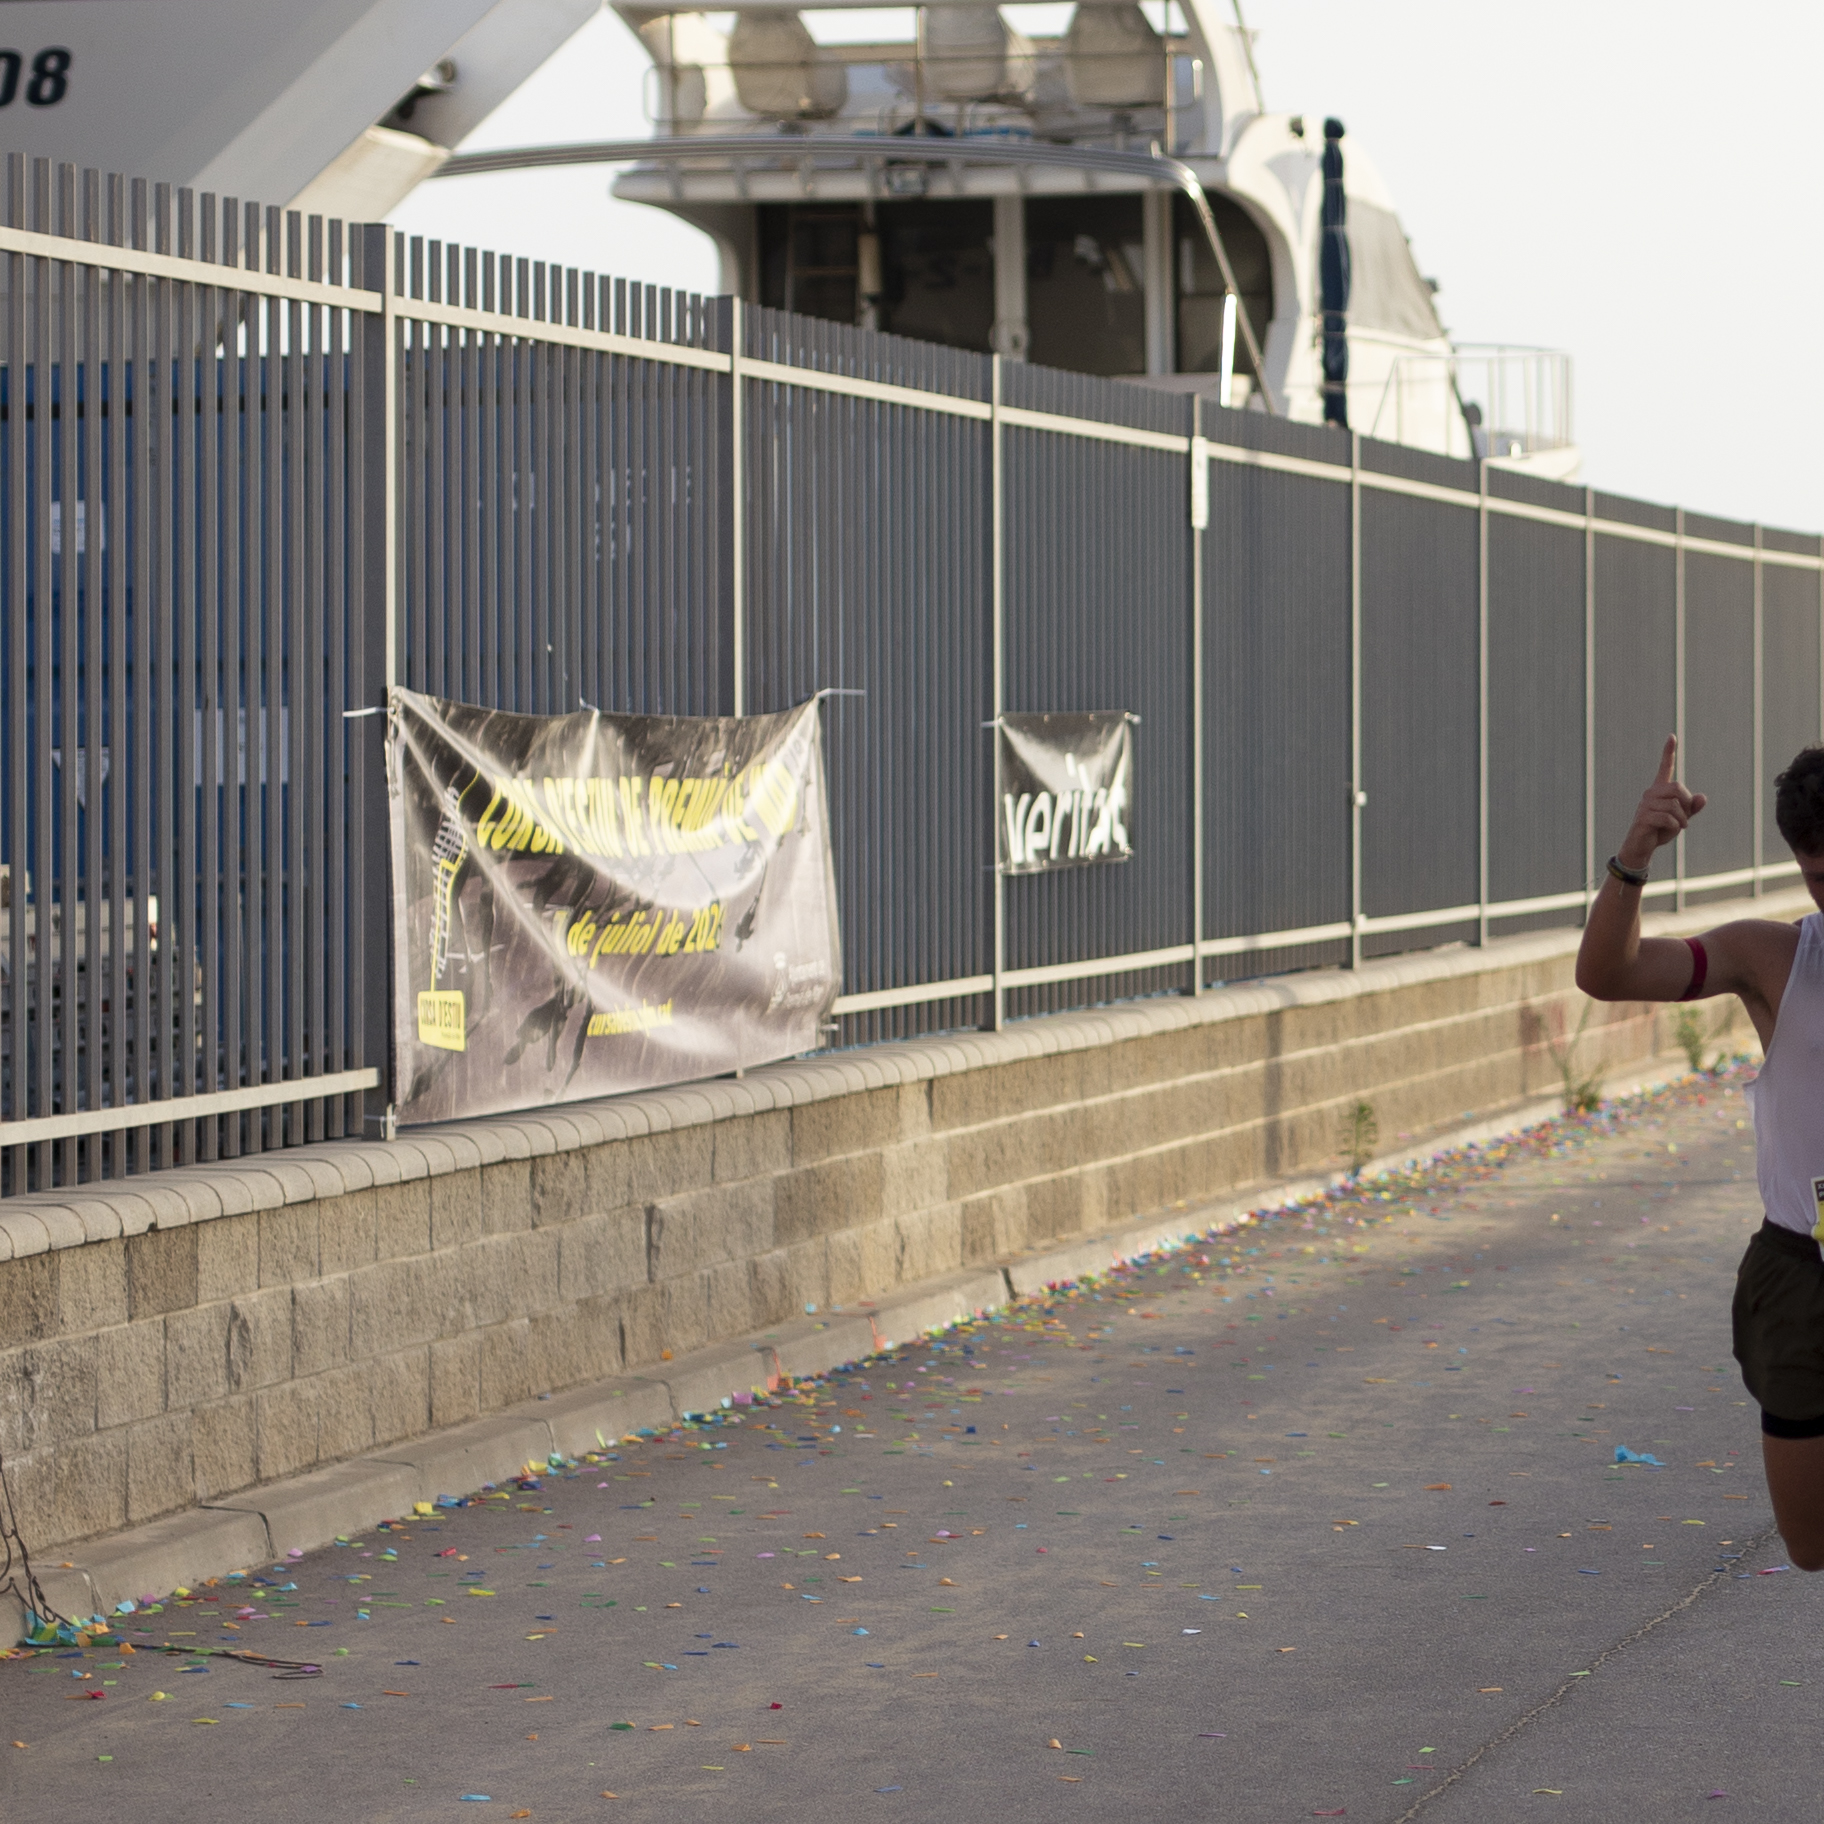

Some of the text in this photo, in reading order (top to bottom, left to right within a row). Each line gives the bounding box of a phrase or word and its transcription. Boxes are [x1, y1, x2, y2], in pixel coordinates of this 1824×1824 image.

[566, 909, 597, 957] de
[588, 909, 664, 970] juliol
[655, 908, 684, 956] de
